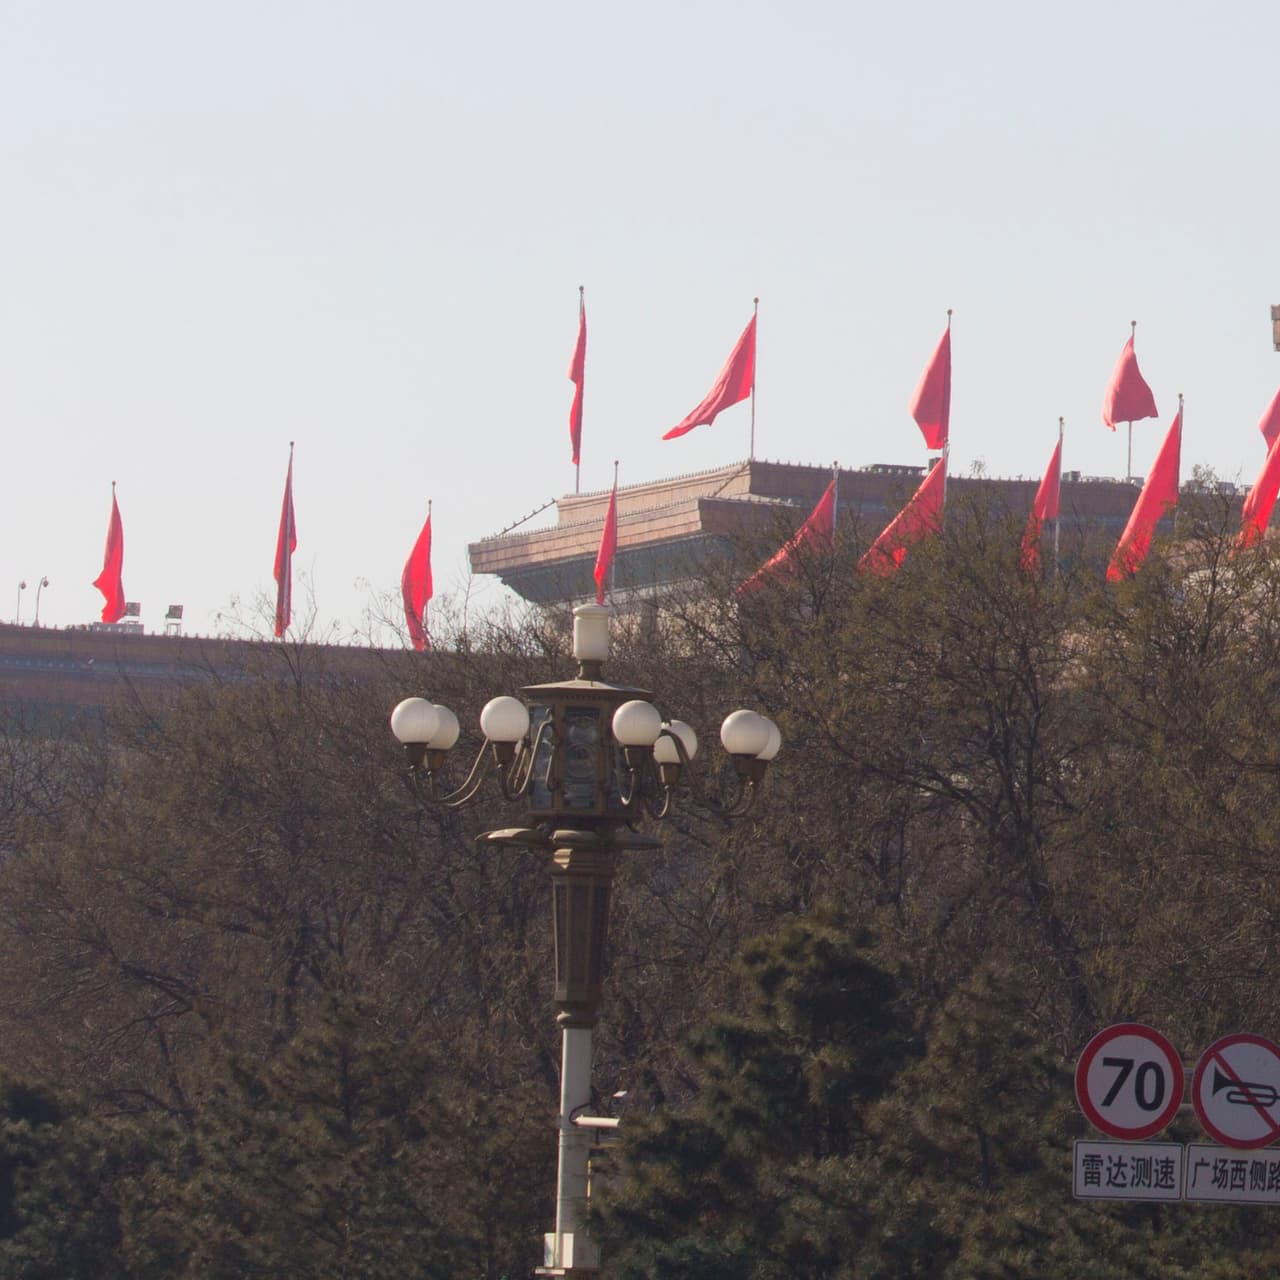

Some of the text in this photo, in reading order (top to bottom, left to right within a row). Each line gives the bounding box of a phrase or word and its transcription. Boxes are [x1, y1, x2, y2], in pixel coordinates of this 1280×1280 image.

[1101, 1057, 1165, 1111] 70
[1083, 1154, 1175, 1190] 雷达测速
